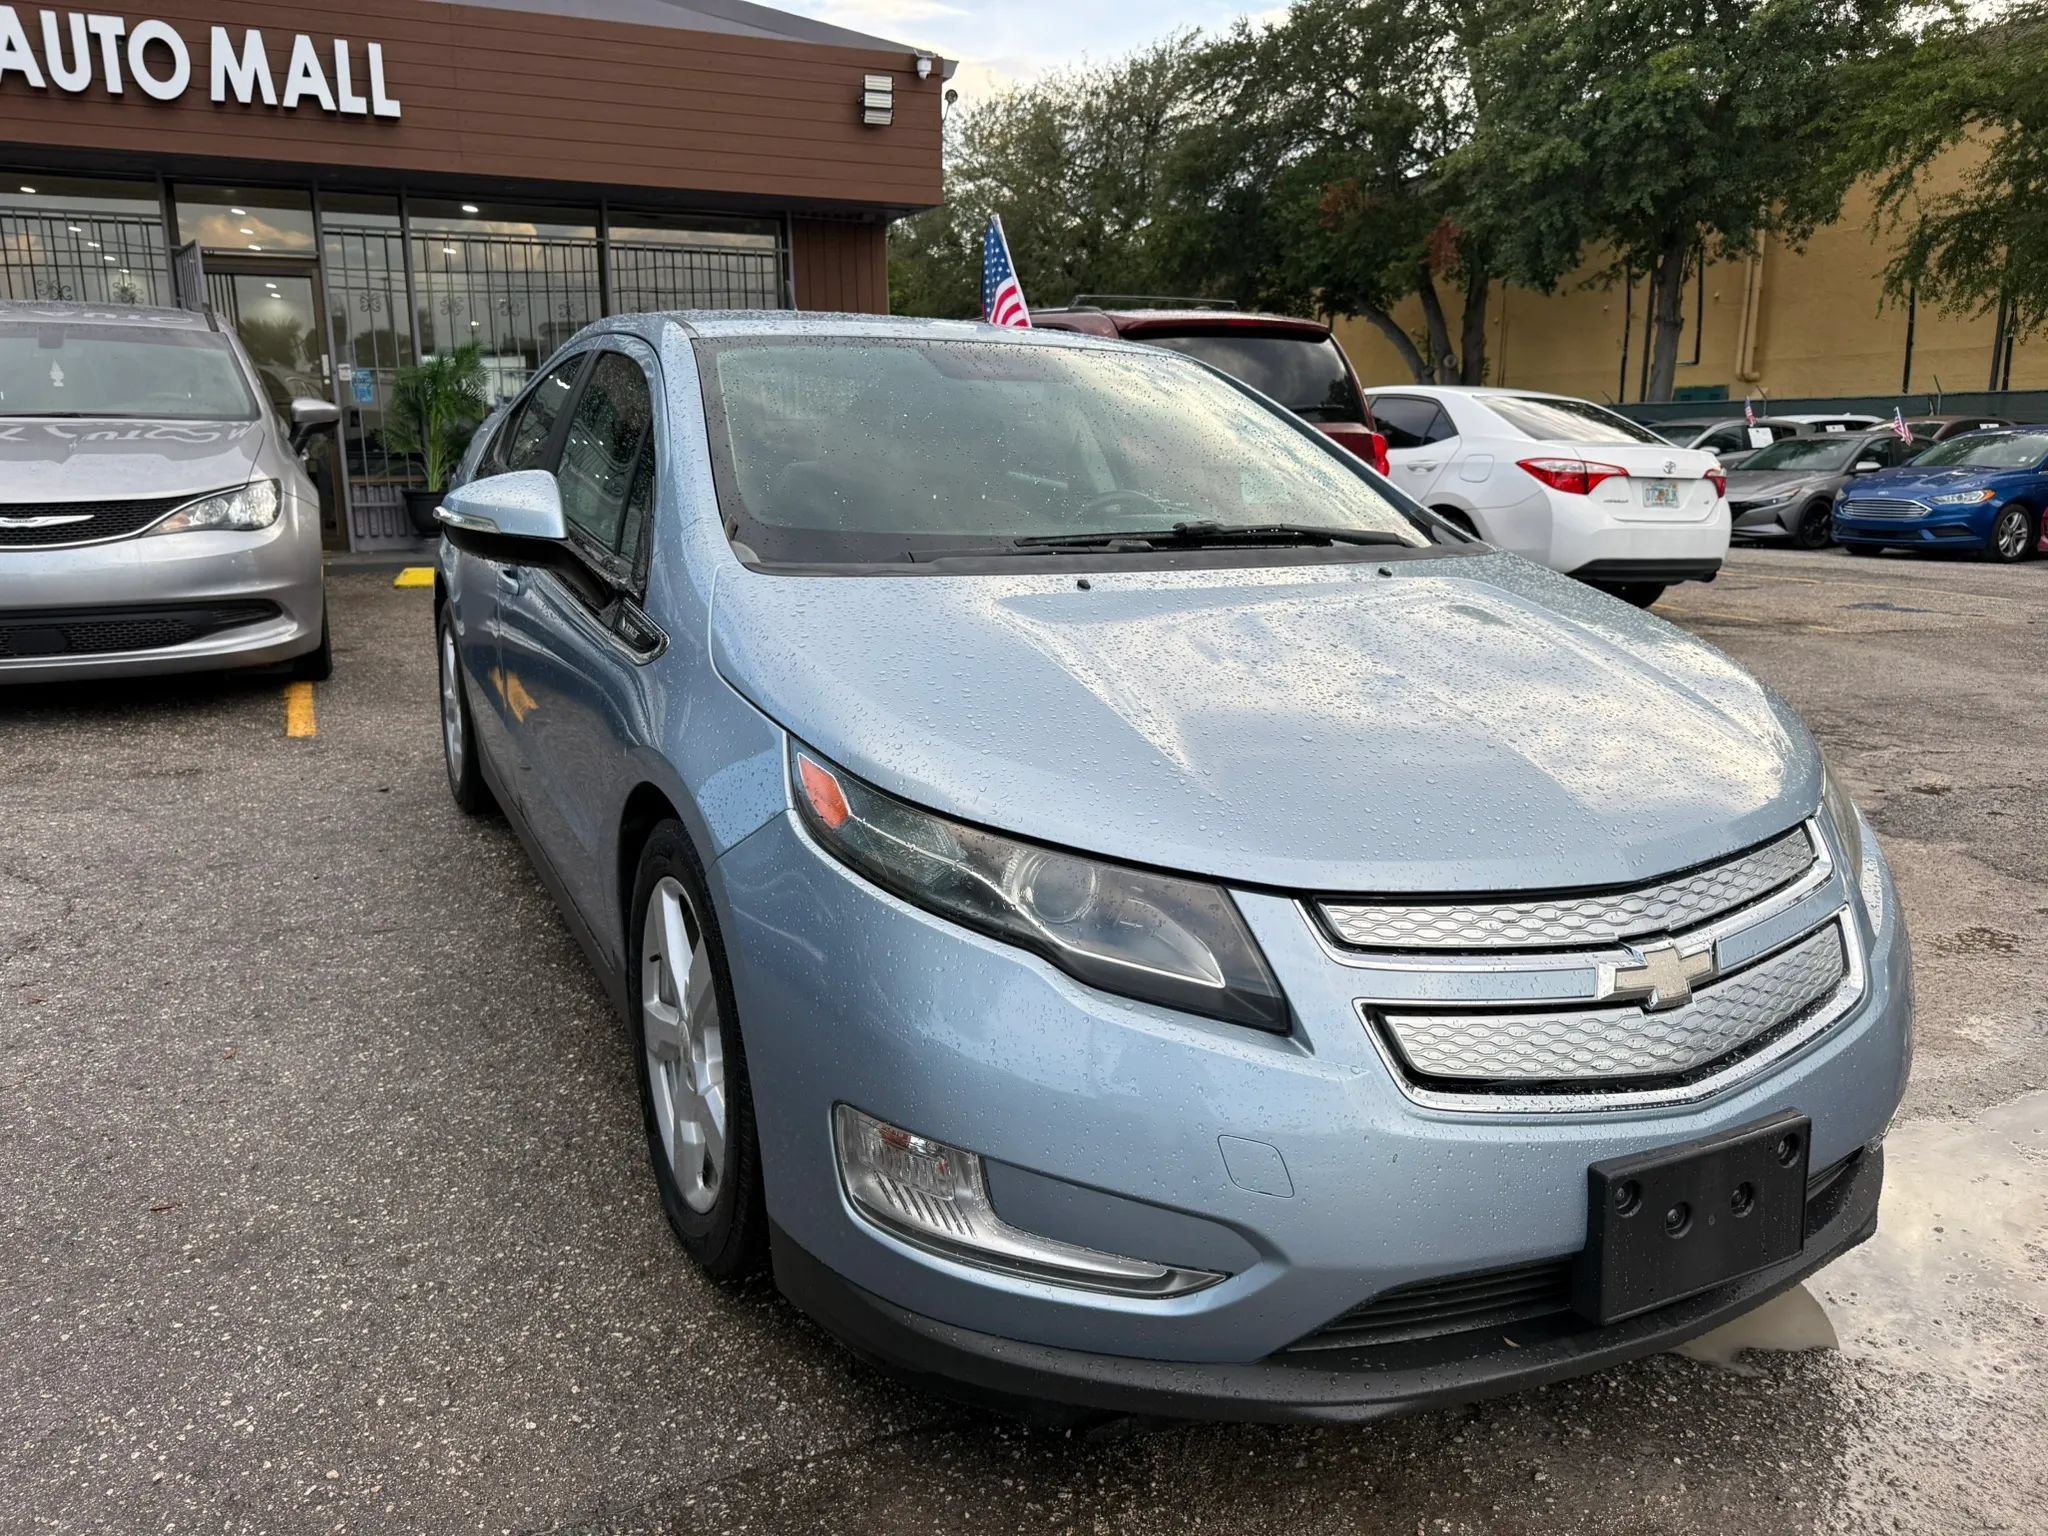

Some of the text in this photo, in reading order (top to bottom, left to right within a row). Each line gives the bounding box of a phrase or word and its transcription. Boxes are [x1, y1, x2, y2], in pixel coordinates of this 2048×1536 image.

[0, 5, 401, 118] AUTO MALL
[620, 616, 640, 638] VOLT
